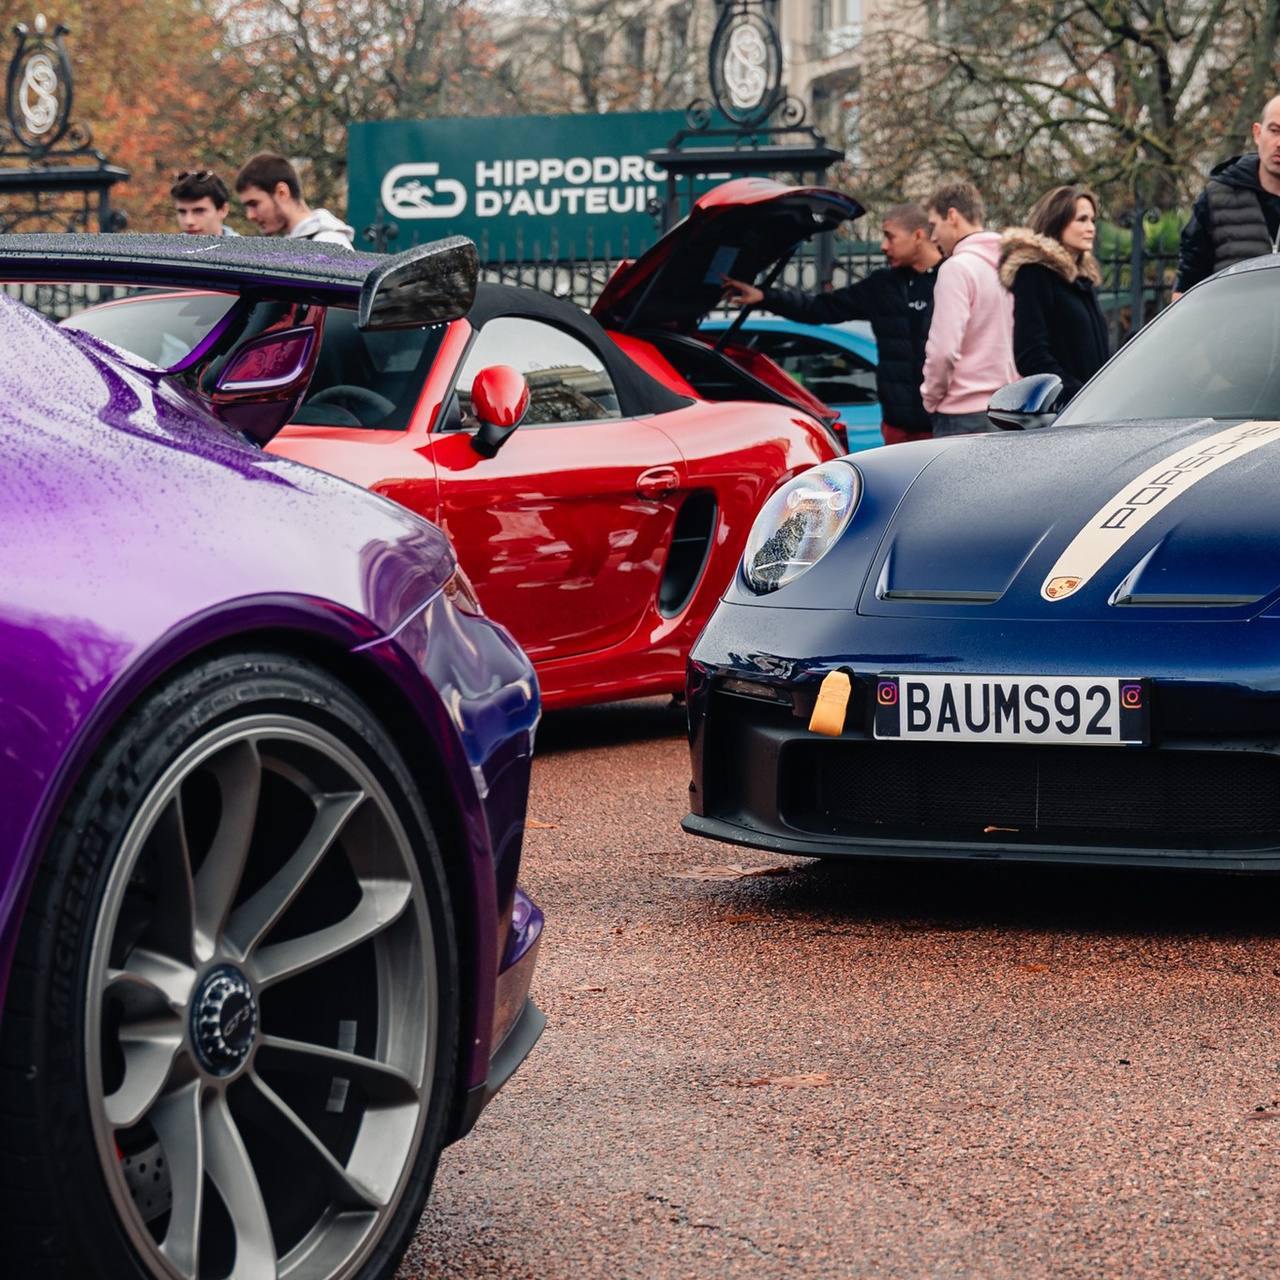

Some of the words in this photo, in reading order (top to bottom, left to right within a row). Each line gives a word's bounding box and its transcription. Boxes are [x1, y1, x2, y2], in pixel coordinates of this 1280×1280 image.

[475, 156, 731, 187] HIPPODRO
[1100, 426, 1279, 529] PORSCHE
[907, 682, 1112, 736] BAUMS92
[223, 1005, 250, 1037] GT3
